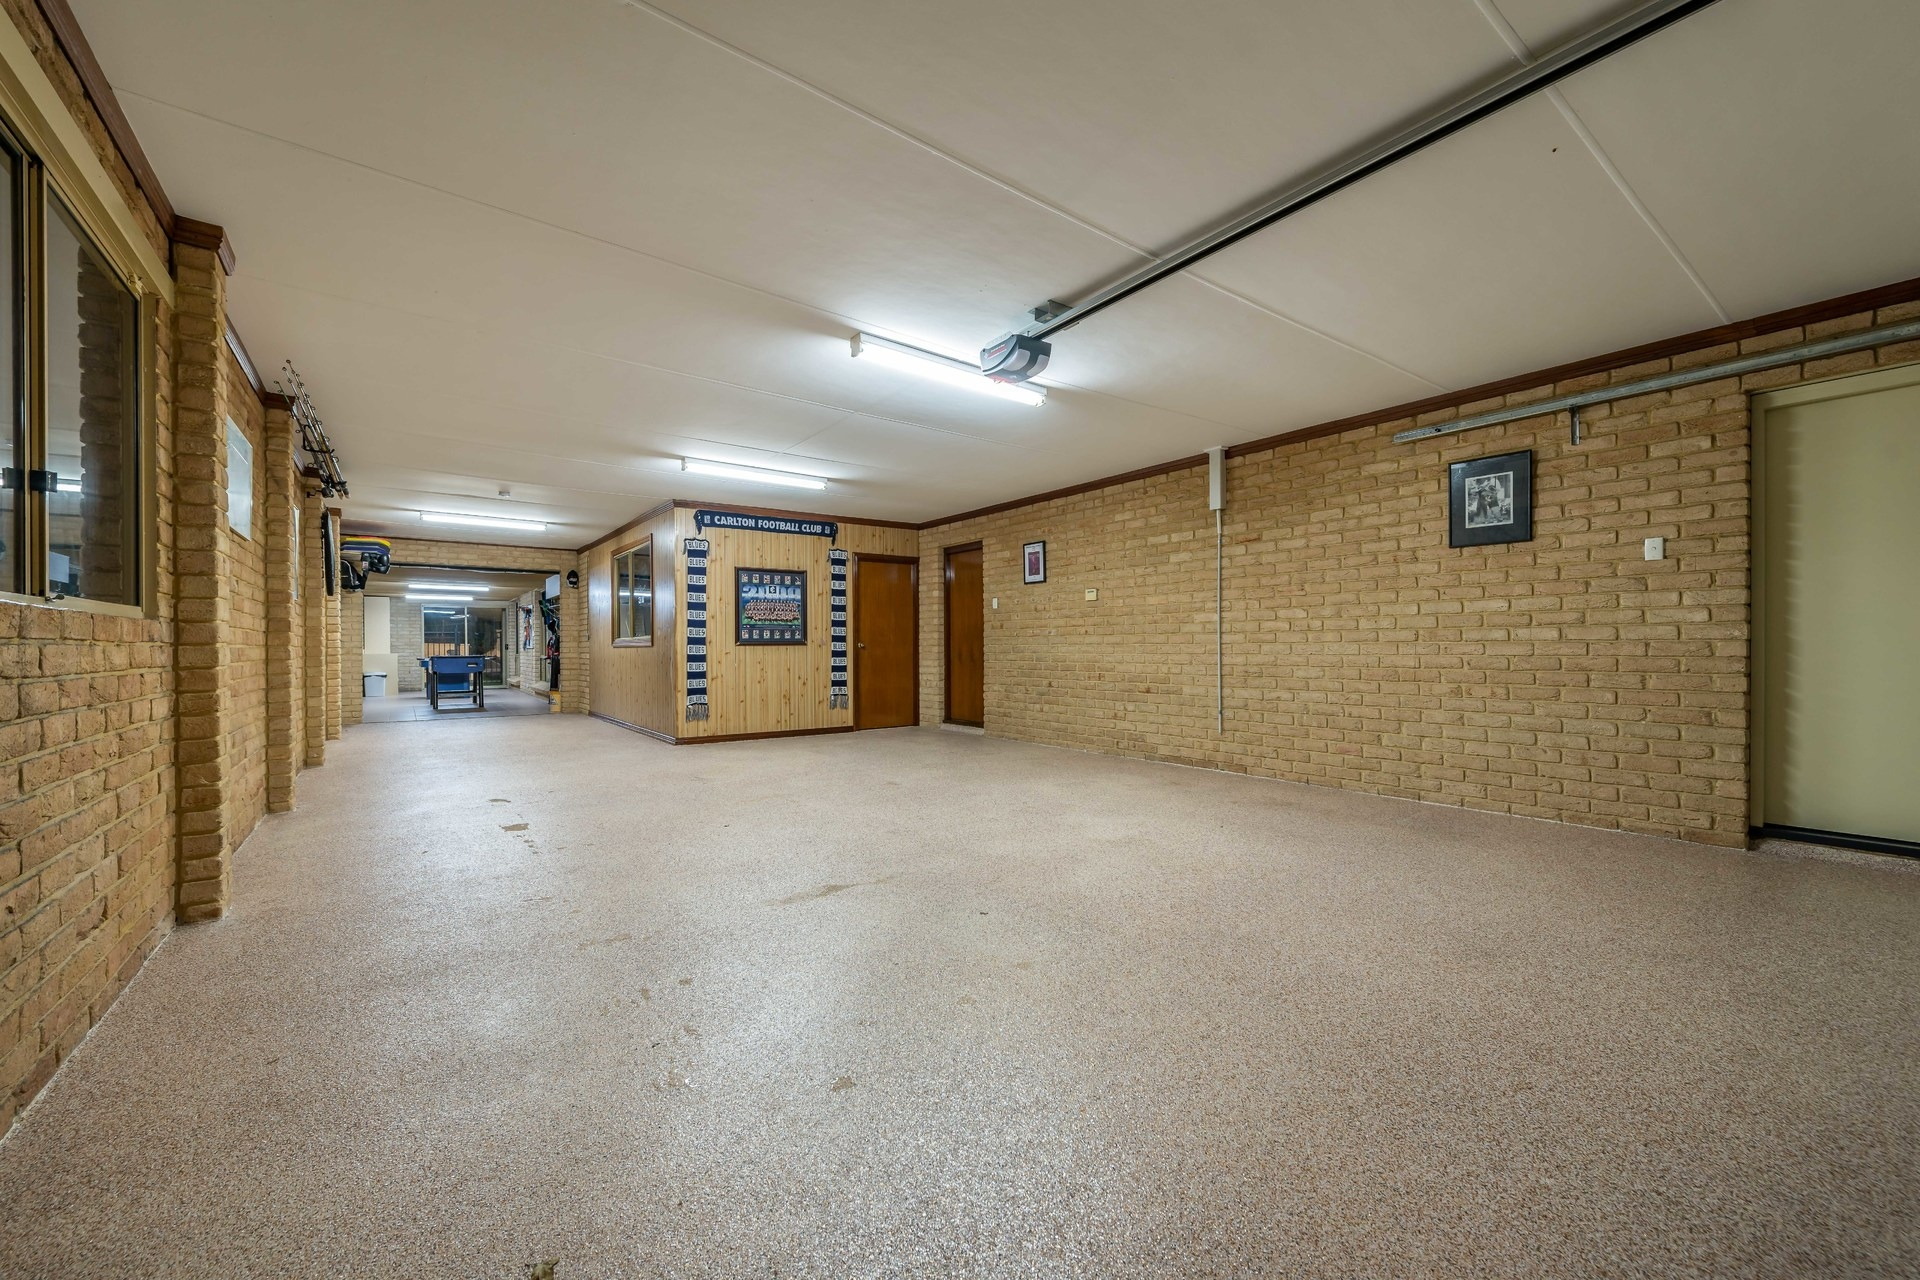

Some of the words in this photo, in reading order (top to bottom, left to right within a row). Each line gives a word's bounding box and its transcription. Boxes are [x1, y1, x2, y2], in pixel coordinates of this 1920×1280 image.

[714, 515, 755, 527] CARLTON
[758, 519, 799, 531] FOOTBALL
[801, 523, 822, 533] CLUB
[688, 541, 706, 549] BLUES
[688, 558, 706, 567] BLUES
[689, 575, 705, 584] BLUES
[688, 593, 705, 602] BLUES
[688, 611, 706, 619] BLUES
[832, 612, 846, 620] BLUES
[688, 628, 706, 637] BLUES
[832, 627, 846, 635] BLUES
[688, 646, 705, 654] BLUES
[688, 663, 705, 671] BLUES
[832, 672, 846, 680] BLUES
[688, 680, 706, 688] BLUES
[688, 696, 706, 704] BLUES
